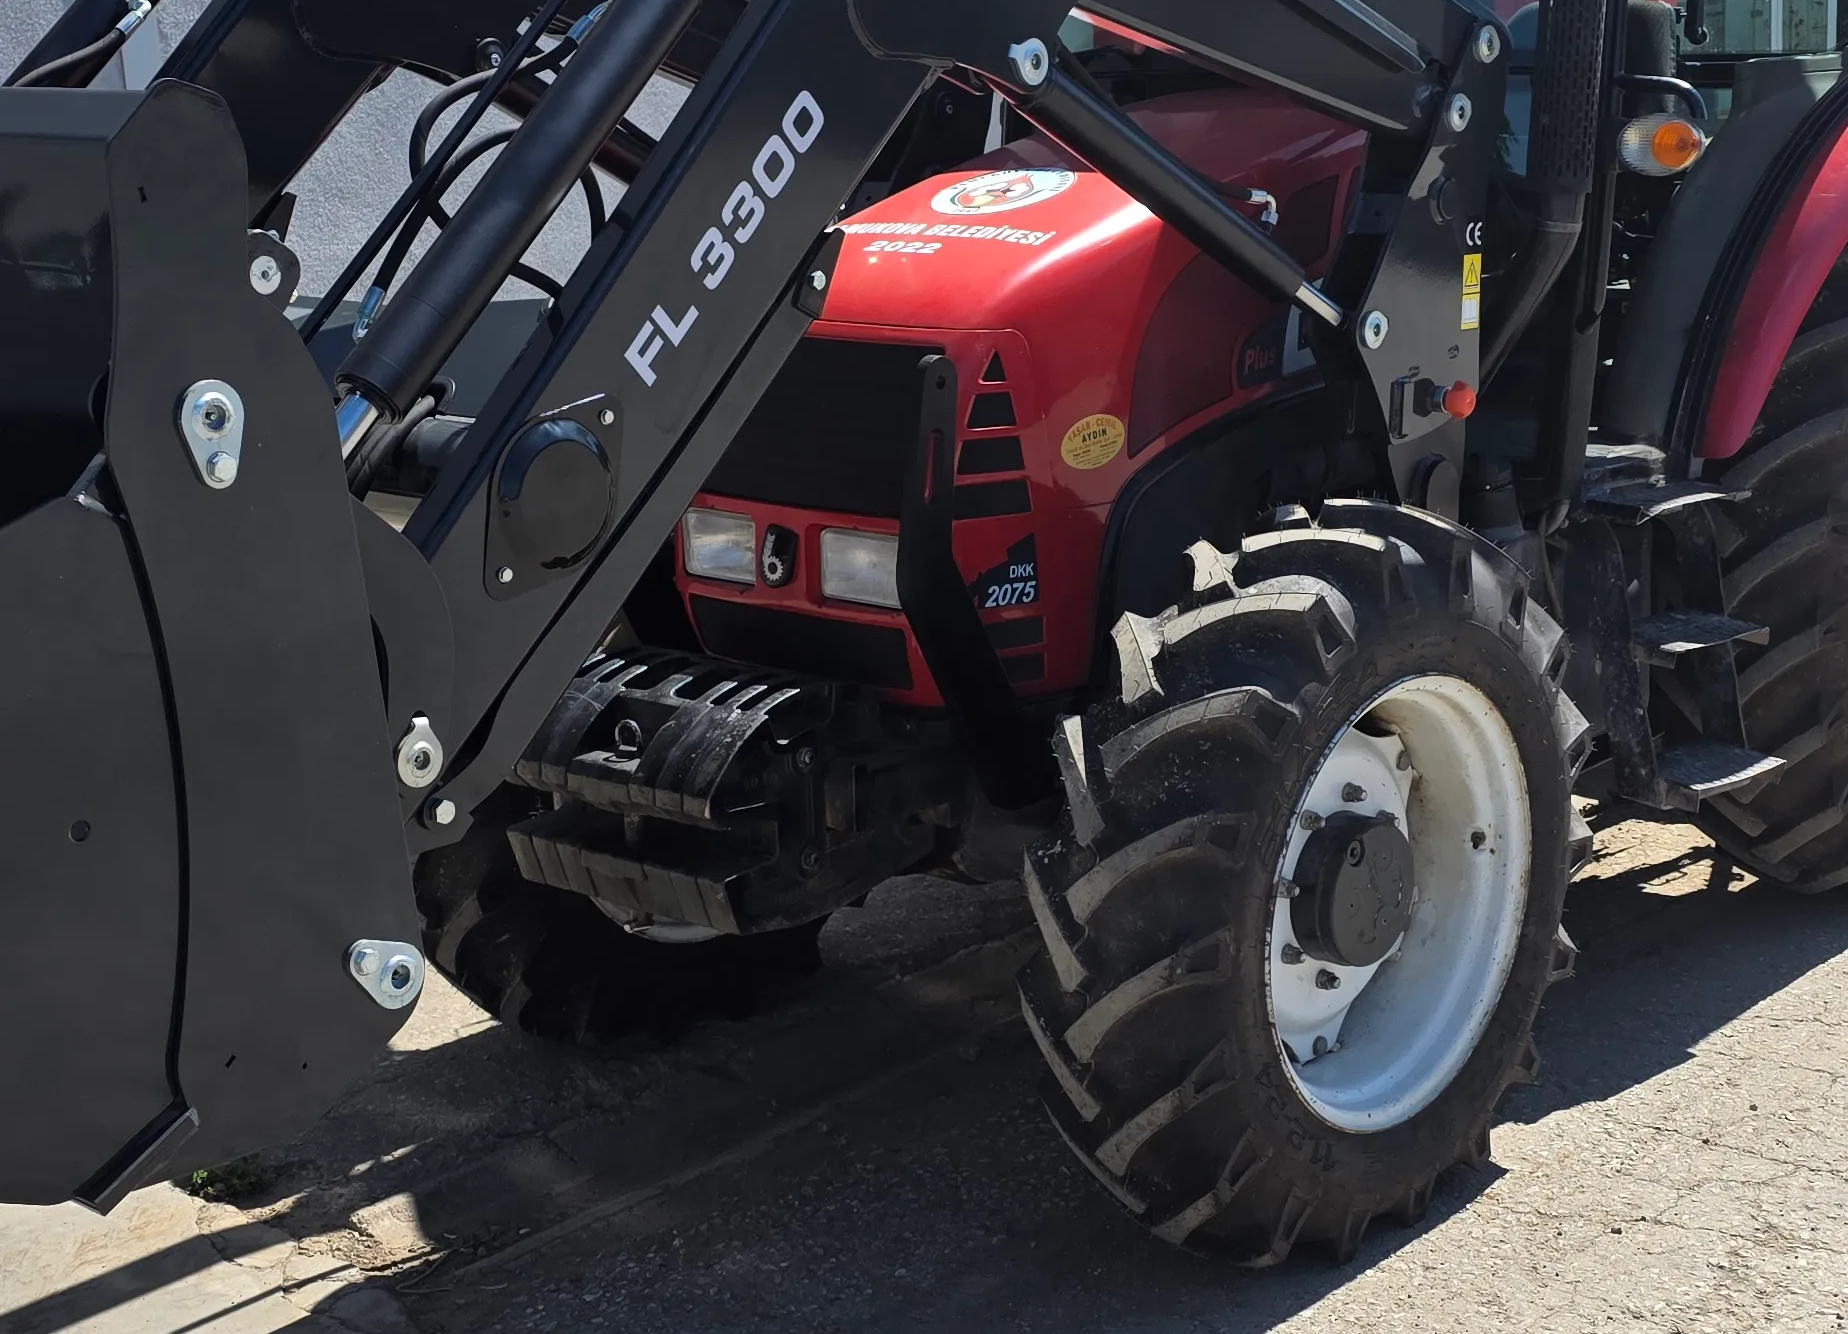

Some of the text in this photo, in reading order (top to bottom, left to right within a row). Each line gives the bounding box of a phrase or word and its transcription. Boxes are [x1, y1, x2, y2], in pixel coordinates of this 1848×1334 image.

[624, 90, 825, 387] FL 3300
[824, 223, 1057, 246] MUKOVA BELEDİYESİ
[1465, 221, 1483, 246] CE
[862, 240, 942, 254] 2022
[1081, 427, 1108, 444] AYDIN
[1009, 562, 1035, 579] DKK
[984, 580, 1037, 608] 2075
